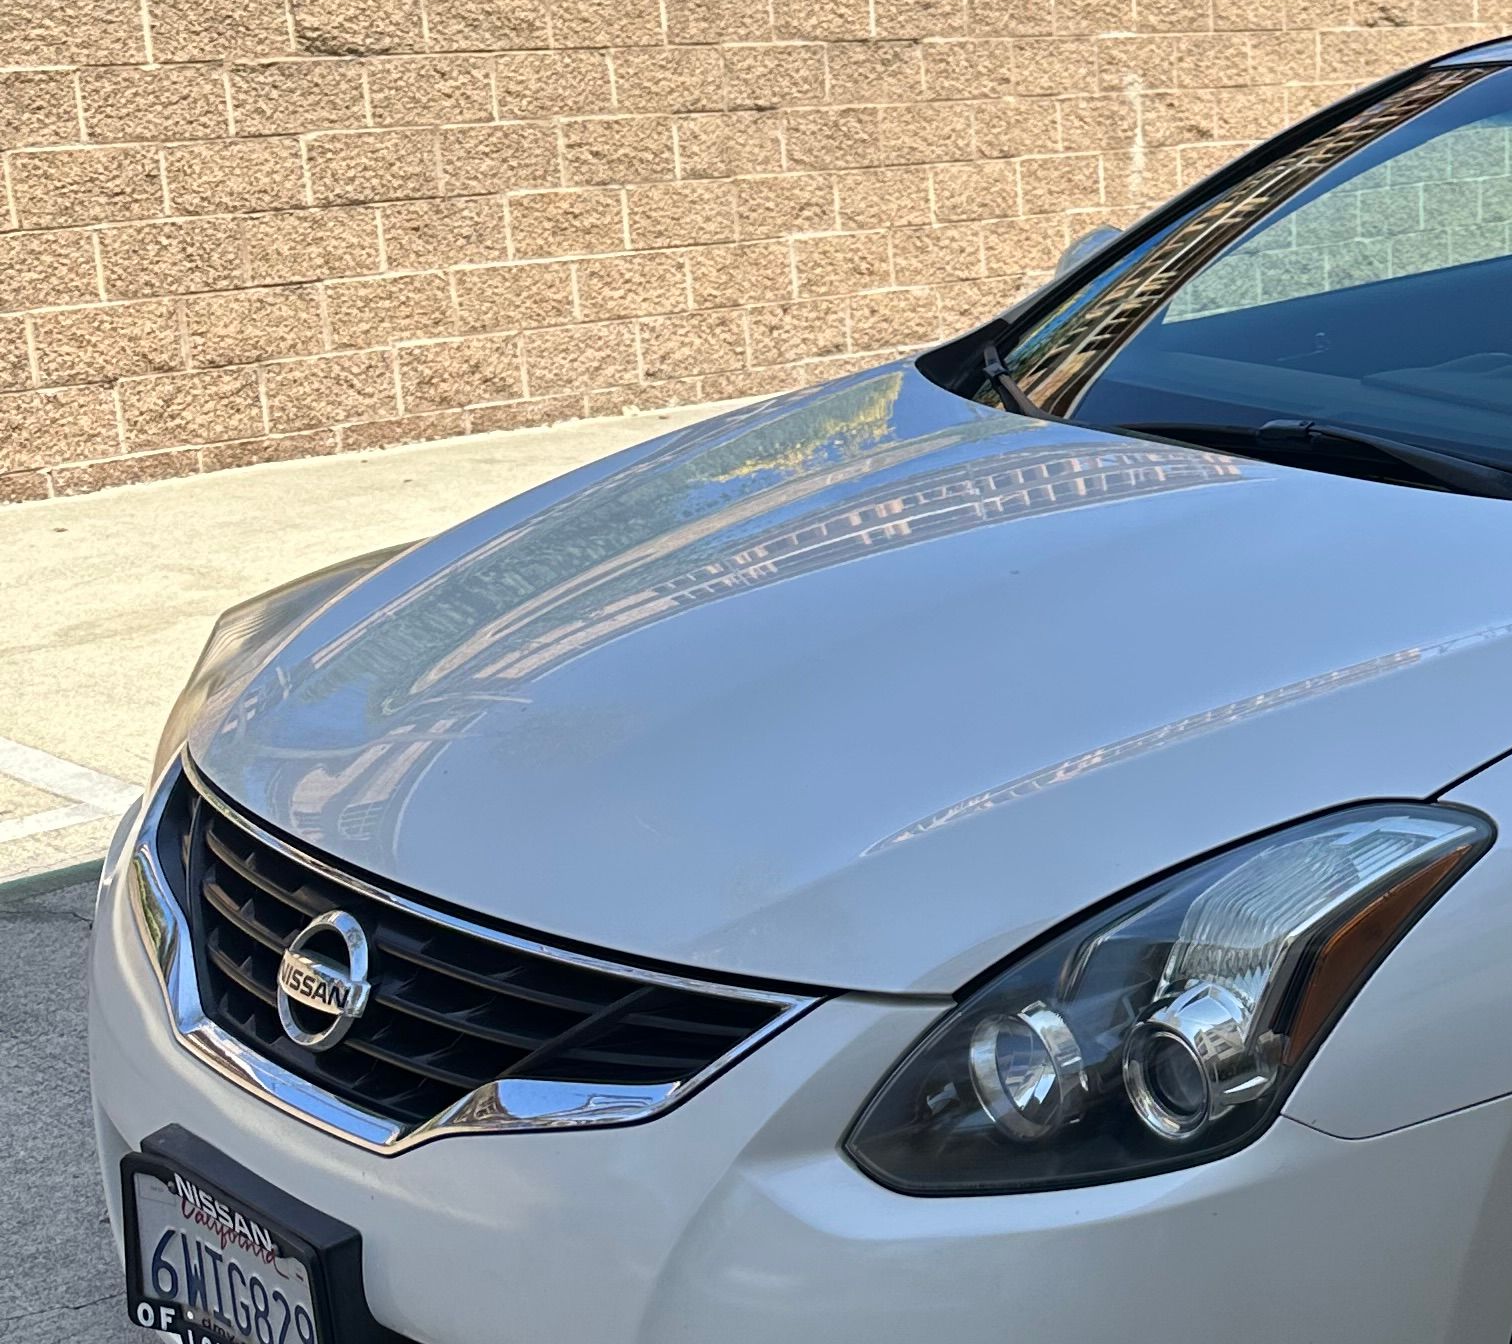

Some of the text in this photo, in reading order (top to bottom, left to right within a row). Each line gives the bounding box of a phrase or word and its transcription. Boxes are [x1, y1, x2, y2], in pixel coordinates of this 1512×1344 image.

[279, 958, 351, 1009] NISSAN
[173, 1172, 274, 1253] NISSAN
[136, 1301, 176, 1331] OF
